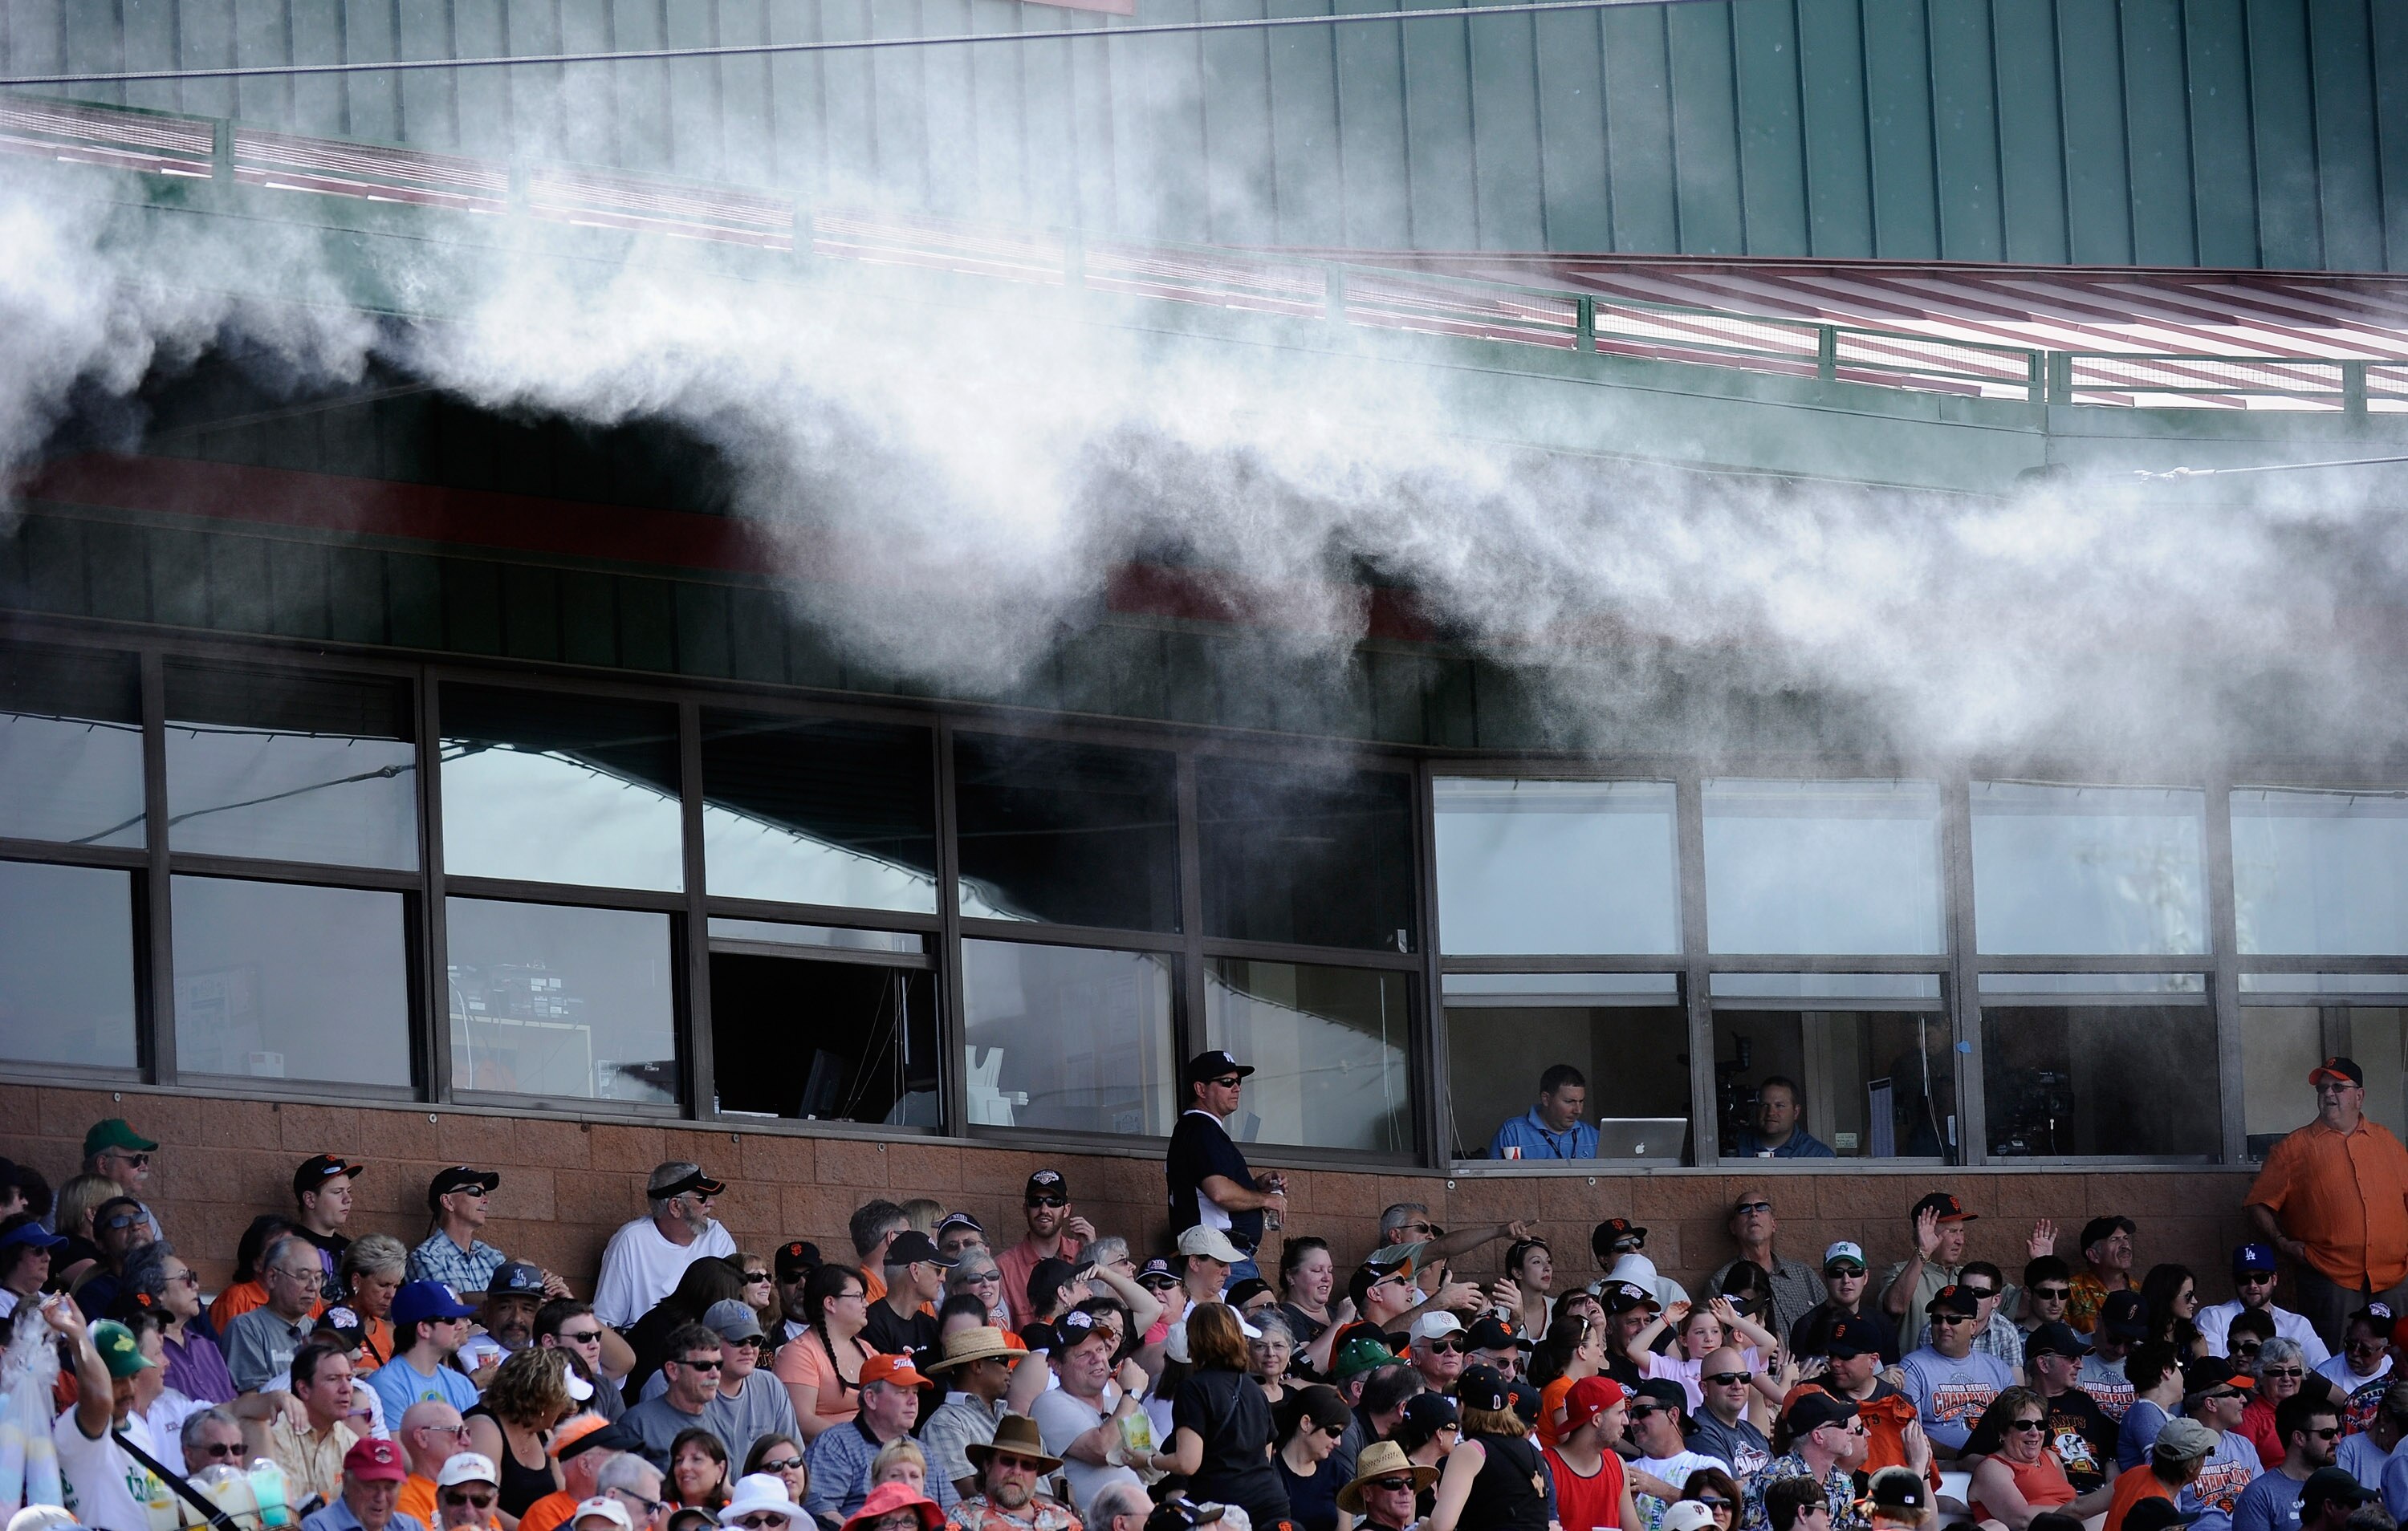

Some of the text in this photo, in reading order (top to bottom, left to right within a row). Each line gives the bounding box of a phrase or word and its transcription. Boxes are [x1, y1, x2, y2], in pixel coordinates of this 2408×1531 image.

[2244, 1247, 2256, 1261] LA
[1939, 1383, 1991, 1393] WORLD SERIES
[2084, 1381, 2135, 1394] WORLD SERIE
[2048, 1415, 2087, 1429] ANTS
[2199, 1463, 2221, 1476] WORLD
